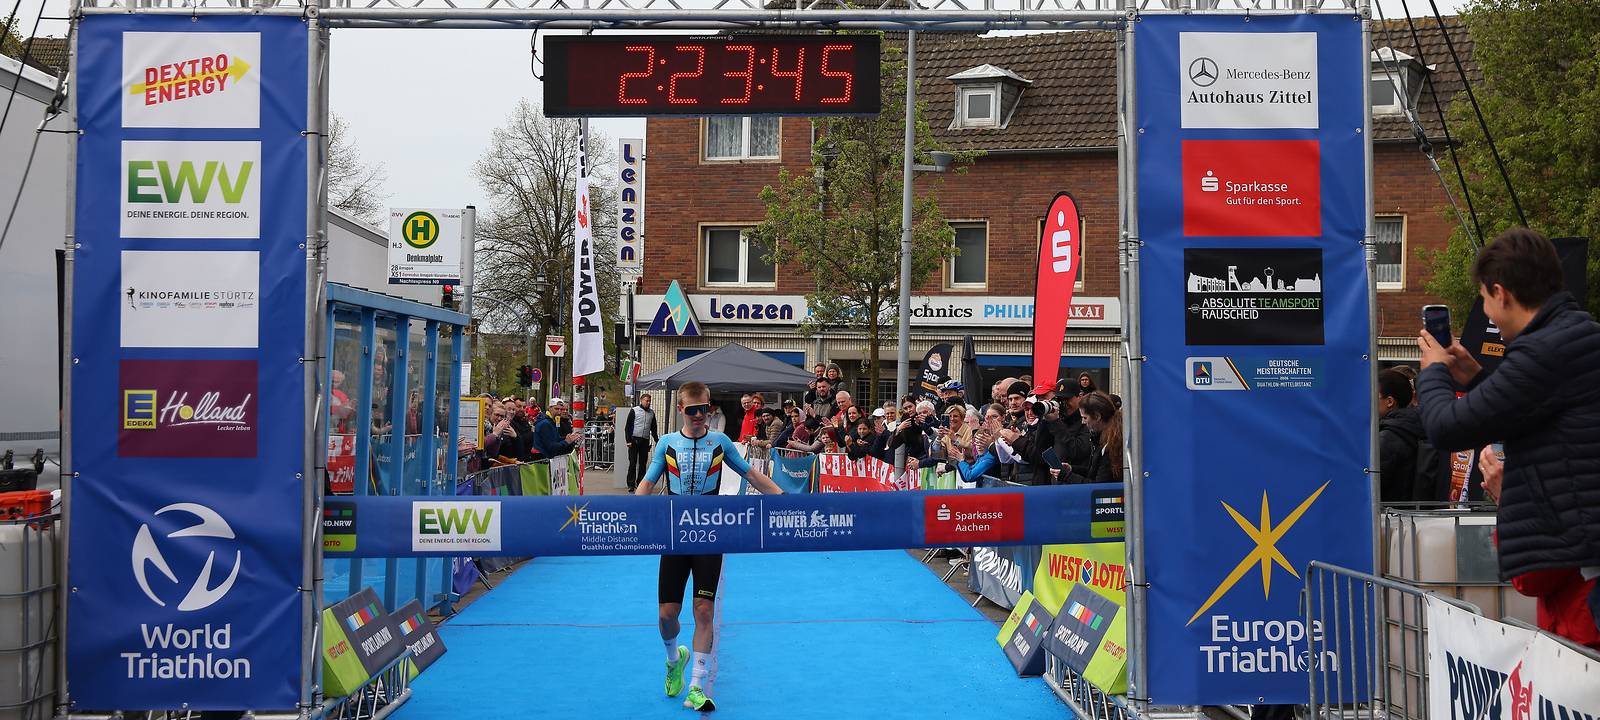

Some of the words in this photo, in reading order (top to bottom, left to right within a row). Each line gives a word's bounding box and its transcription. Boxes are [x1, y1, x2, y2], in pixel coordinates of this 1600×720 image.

[145, 53, 229, 86] DEXTRO
[618, 45, 853, 104] 2:23:45
[1226, 69, 1311, 80] Mercedes-Benz
[145, 73, 229, 106] ENERGY
[1187, 90, 1264, 104] Autohaus
[1269, 90, 1312, 104] Zittel
[127, 160, 254, 204] EWV
[1225, 181, 1288, 195] Sparkasse
[620, 143, 639, 262] Lenzen
[1226, 197, 1241, 205] Gut
[1242, 196, 1255, 205] für
[1257, 196, 1274, 205] den
[1275, 197, 1302, 207] Sport.
[127, 211, 151, 219] DEINE
[153, 211, 189, 219] ENERGIE.
[190, 211, 215, 219] DEINE
[216, 211, 249, 219] REGION.
[406, 254, 443, 264] Denkmalplatz
[139, 292, 211, 300] KINOFAMILIE
[213, 290, 254, 300] STÜRTZ
[709, 297, 793, 320] Lenzen
[1202, 298, 1257, 308] ABSOLUTE
[1258, 298, 1321, 308] TEAMSPORT
[910, 304, 973, 318] echnics
[983, 304, 1034, 318] PHILIP
[1202, 309, 1259, 320] RAUSCHEID
[160, 390, 252, 424] Holland
[419, 508, 494, 535] EWV
[578, 509, 627, 523] Europe
[678, 508, 755, 526] Alsdorf
[769, 515, 807, 528] POWER
[829, 514, 854, 527] MAN
[955, 510, 1003, 522] Sparkasse
[578, 522, 637, 534] Triathlon
[794, 528, 829, 538] Alsdorf
[955, 523, 990, 532] Aachen
[679, 530, 717, 543] 2026
[1048, 552, 1082, 582] WEST
[140, 623, 231, 649] World
[1212, 615, 1323, 646] Europe
[120, 652, 251, 679] Triathlon
[1199, 646, 1339, 673] Triathlon
